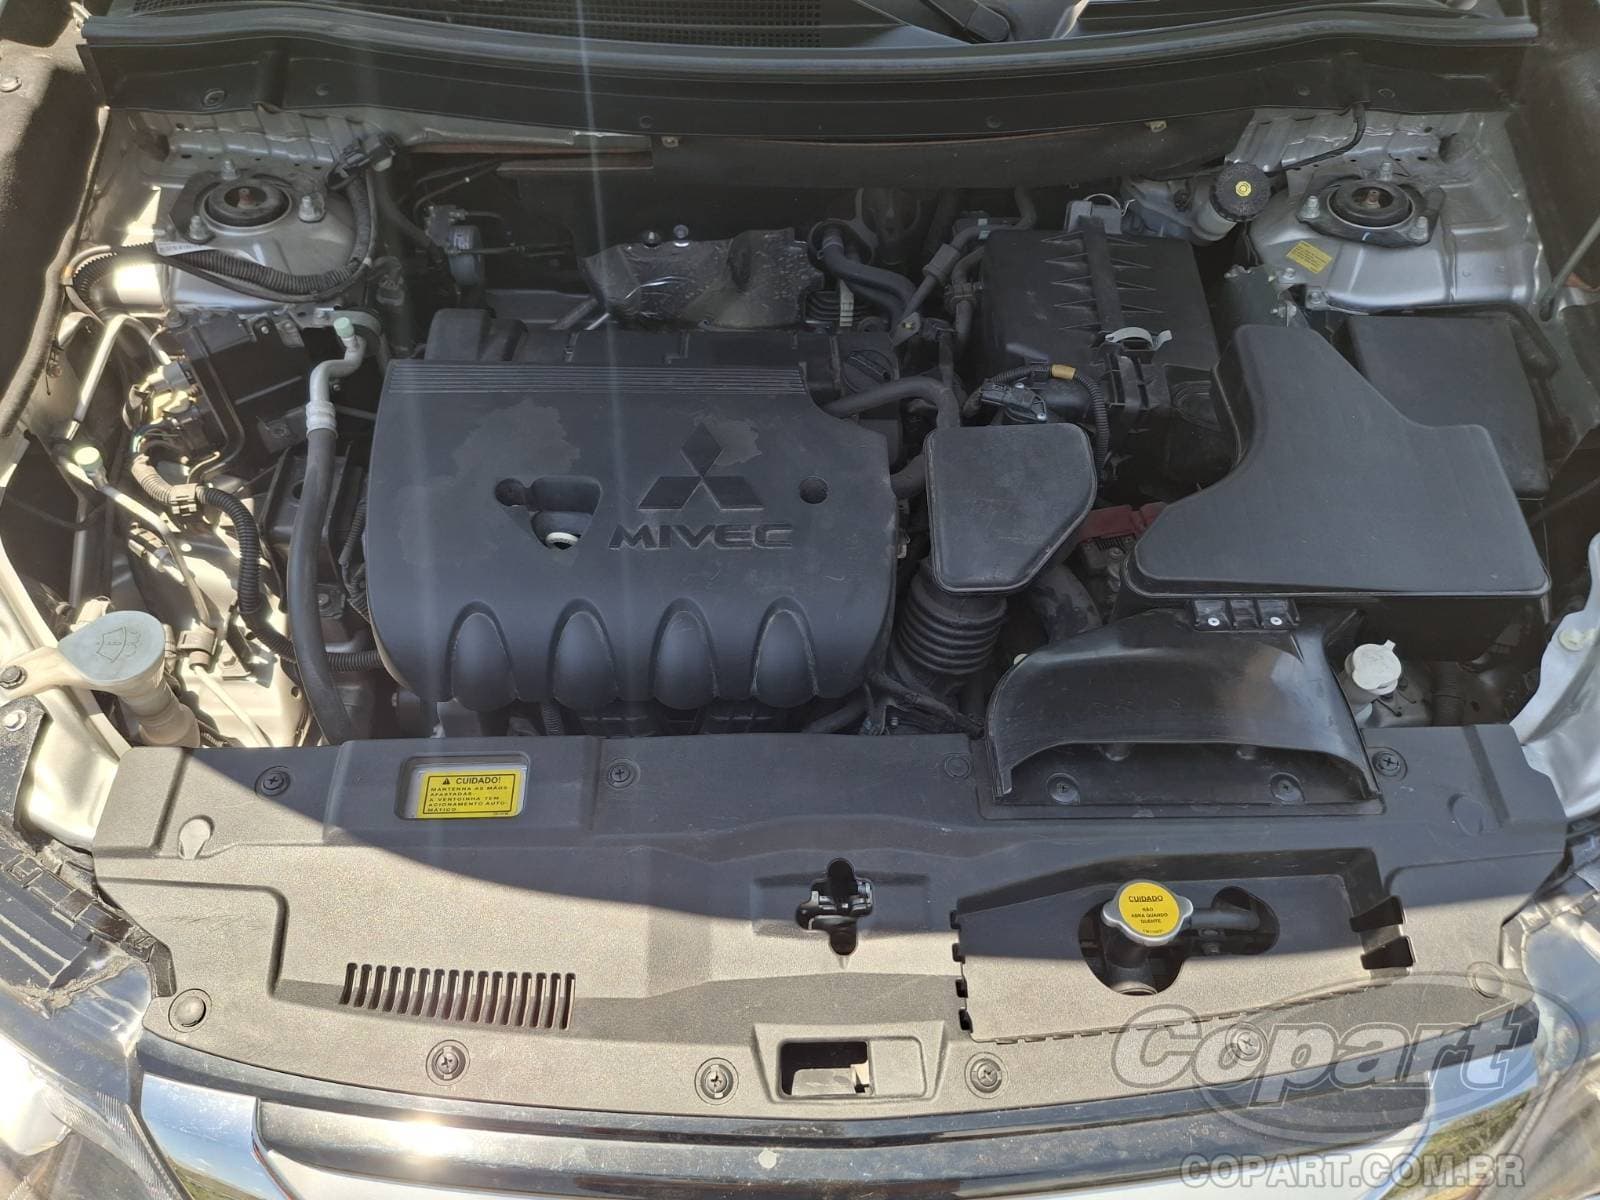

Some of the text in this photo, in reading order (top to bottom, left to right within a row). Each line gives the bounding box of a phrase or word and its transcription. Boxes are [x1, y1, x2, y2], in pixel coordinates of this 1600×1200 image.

[608, 523, 793, 551] MIVEC
[455, 776, 501, 785] CUIDADO!
[1128, 895, 1164, 903] CUIDADO
